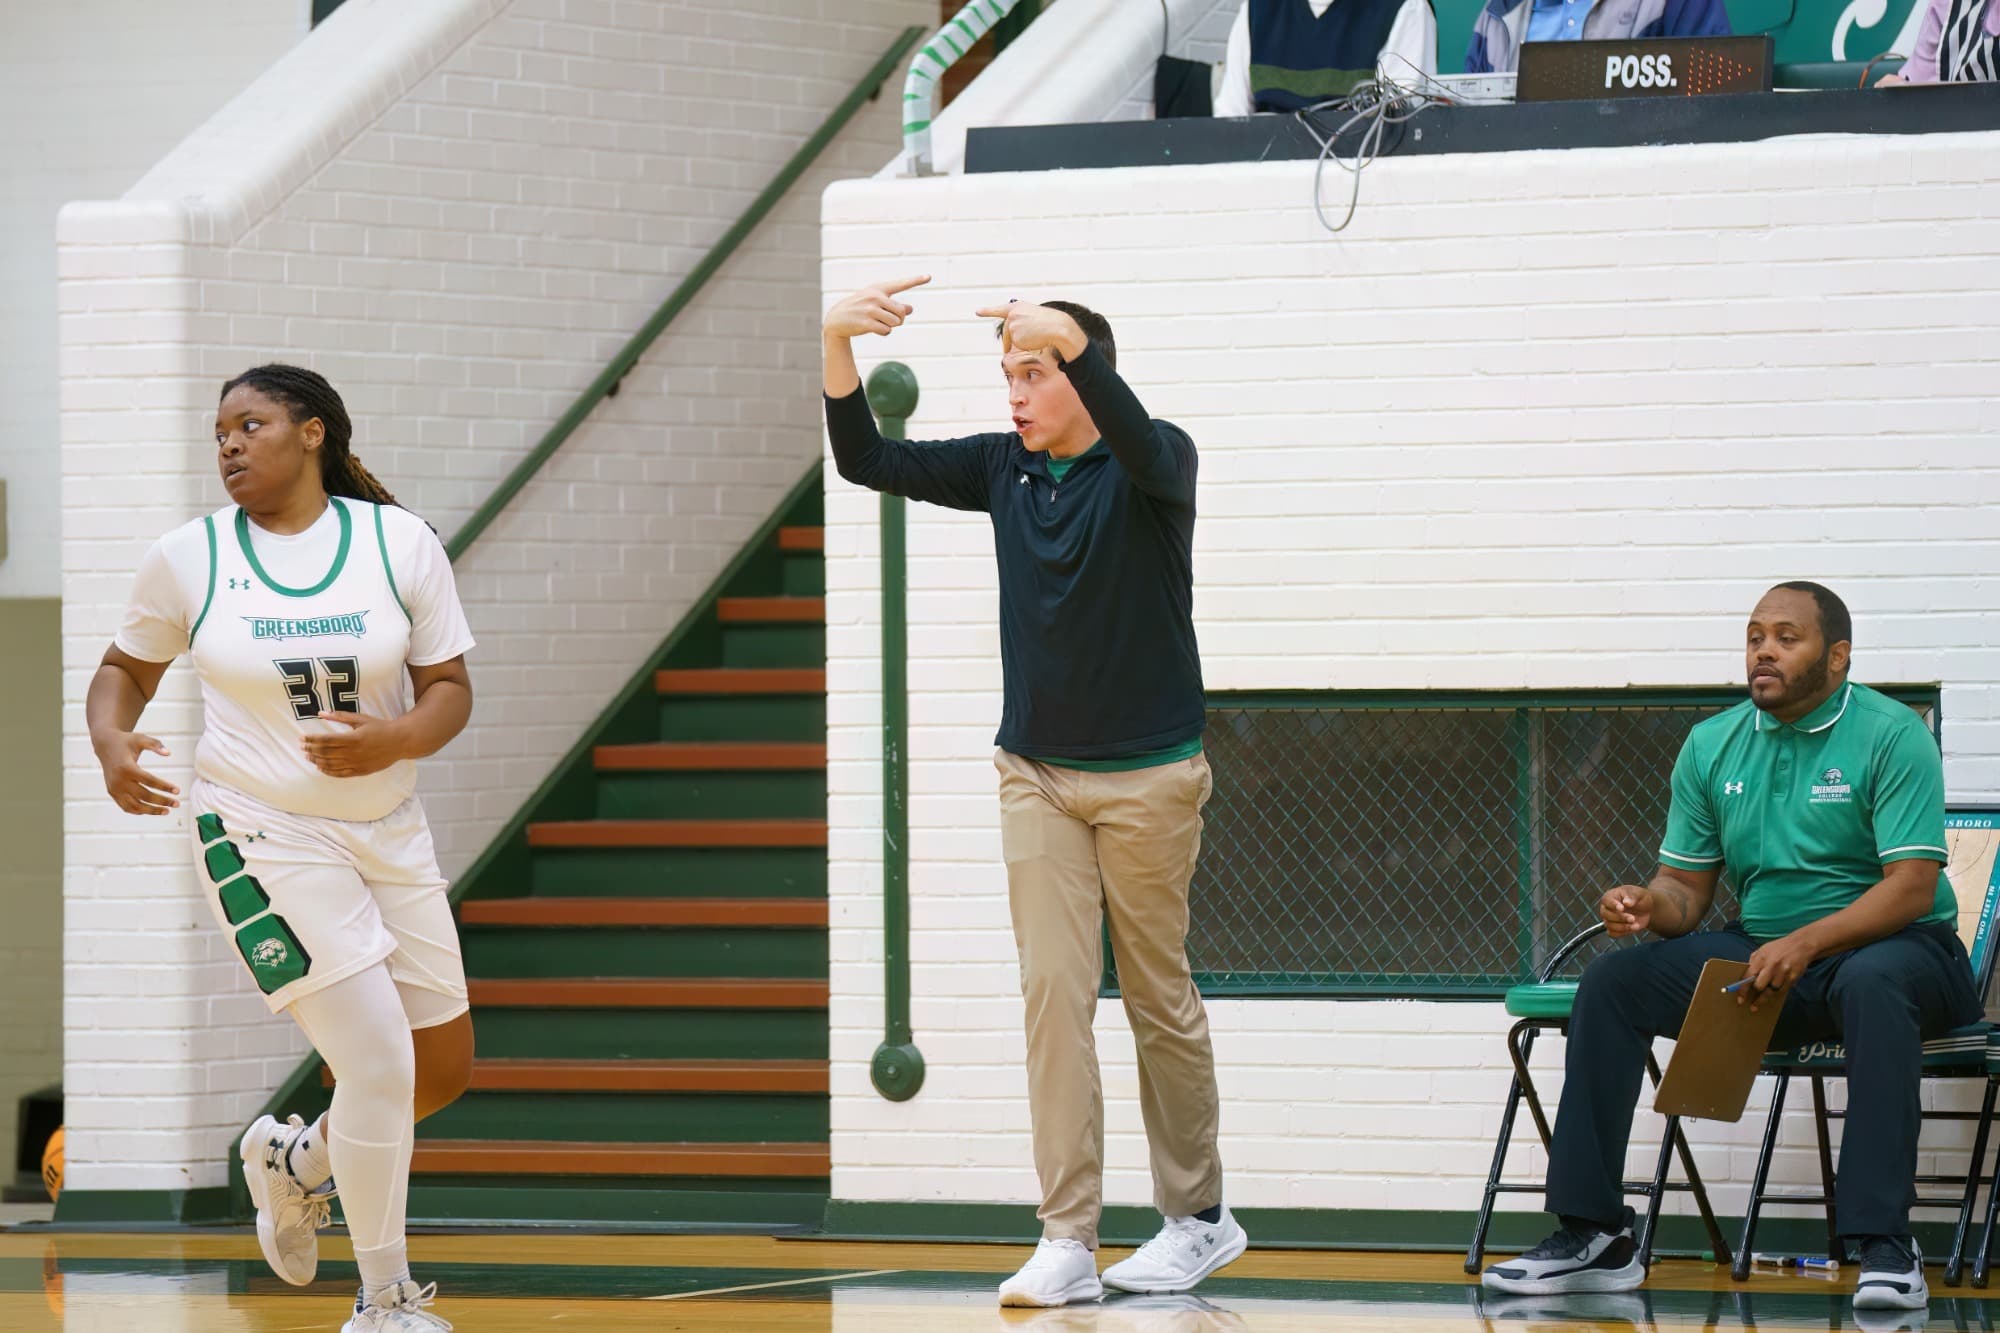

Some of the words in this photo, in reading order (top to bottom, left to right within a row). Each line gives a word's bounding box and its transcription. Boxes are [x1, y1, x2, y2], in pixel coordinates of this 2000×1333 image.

[1605, 54, 1677, 89] POSS.
[252, 612, 366, 639] GREENSBORO
[273, 656, 361, 720] 32
[1944, 819, 1992, 828] SBORO
[1976, 921, 1986, 940] TWO
[1983, 899, 1992, 918] FEET
